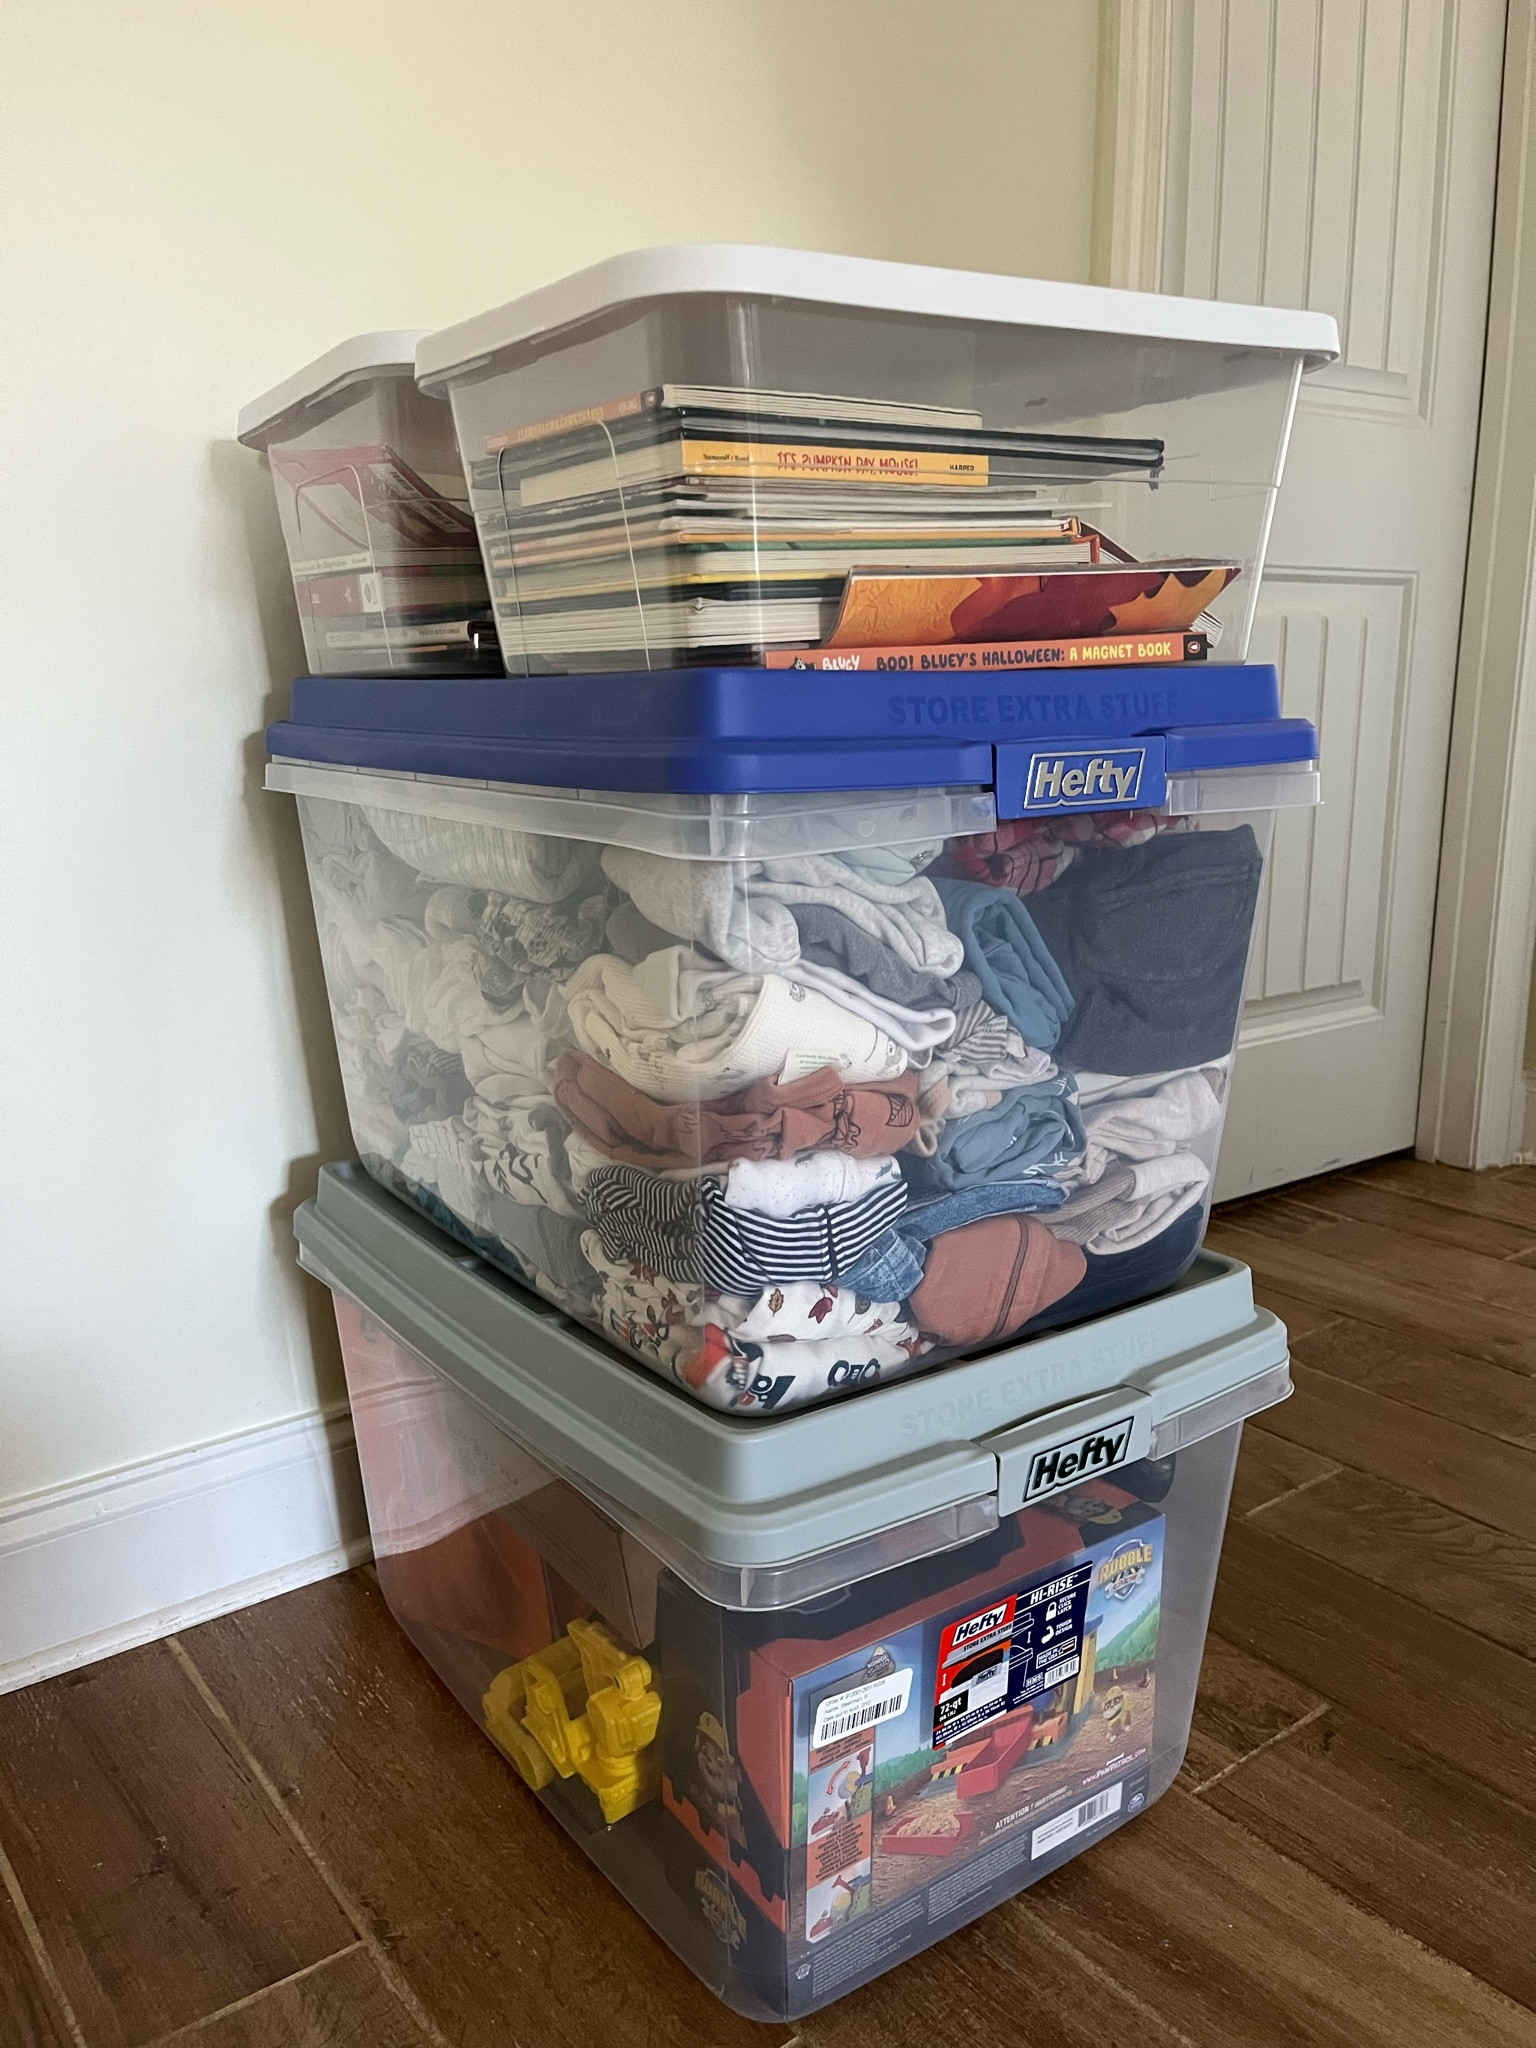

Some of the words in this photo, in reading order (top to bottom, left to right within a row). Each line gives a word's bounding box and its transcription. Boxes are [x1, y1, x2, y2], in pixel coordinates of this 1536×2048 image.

[777, 452, 797, 471] IT'S
[801, 453, 852, 474] PUMPKIN
[879, 457, 919, 477] MOUSE!
[822, 654, 861, 671] BLUEY
[876, 654, 915, 671] BOO!
[921, 651, 978, 670] BLUEY'S
[982, 647, 1065, 666] HALLOWEEN:
[1069, 646, 1079, 662] A
[1081, 643, 1134, 661] MAGNET
[1137, 641, 1172, 658] BOOK
[888, 696, 991, 726] STORE
[996, 693, 1094, 723] EXTRA
[1097, 691, 1177, 719] STUFF
[1033, 757, 1138, 802] Hefty
[901, 1387, 995, 1437] STORE
[1000, 1358, 1084, 1403] EXTRA
[1031, 1431, 1127, 1491] Hefty
[1098, 1543, 1153, 1585] RUBBLE
[955, 1609, 1005, 1643] Hefty
[995, 1804, 1030, 1830] ATTENTION
